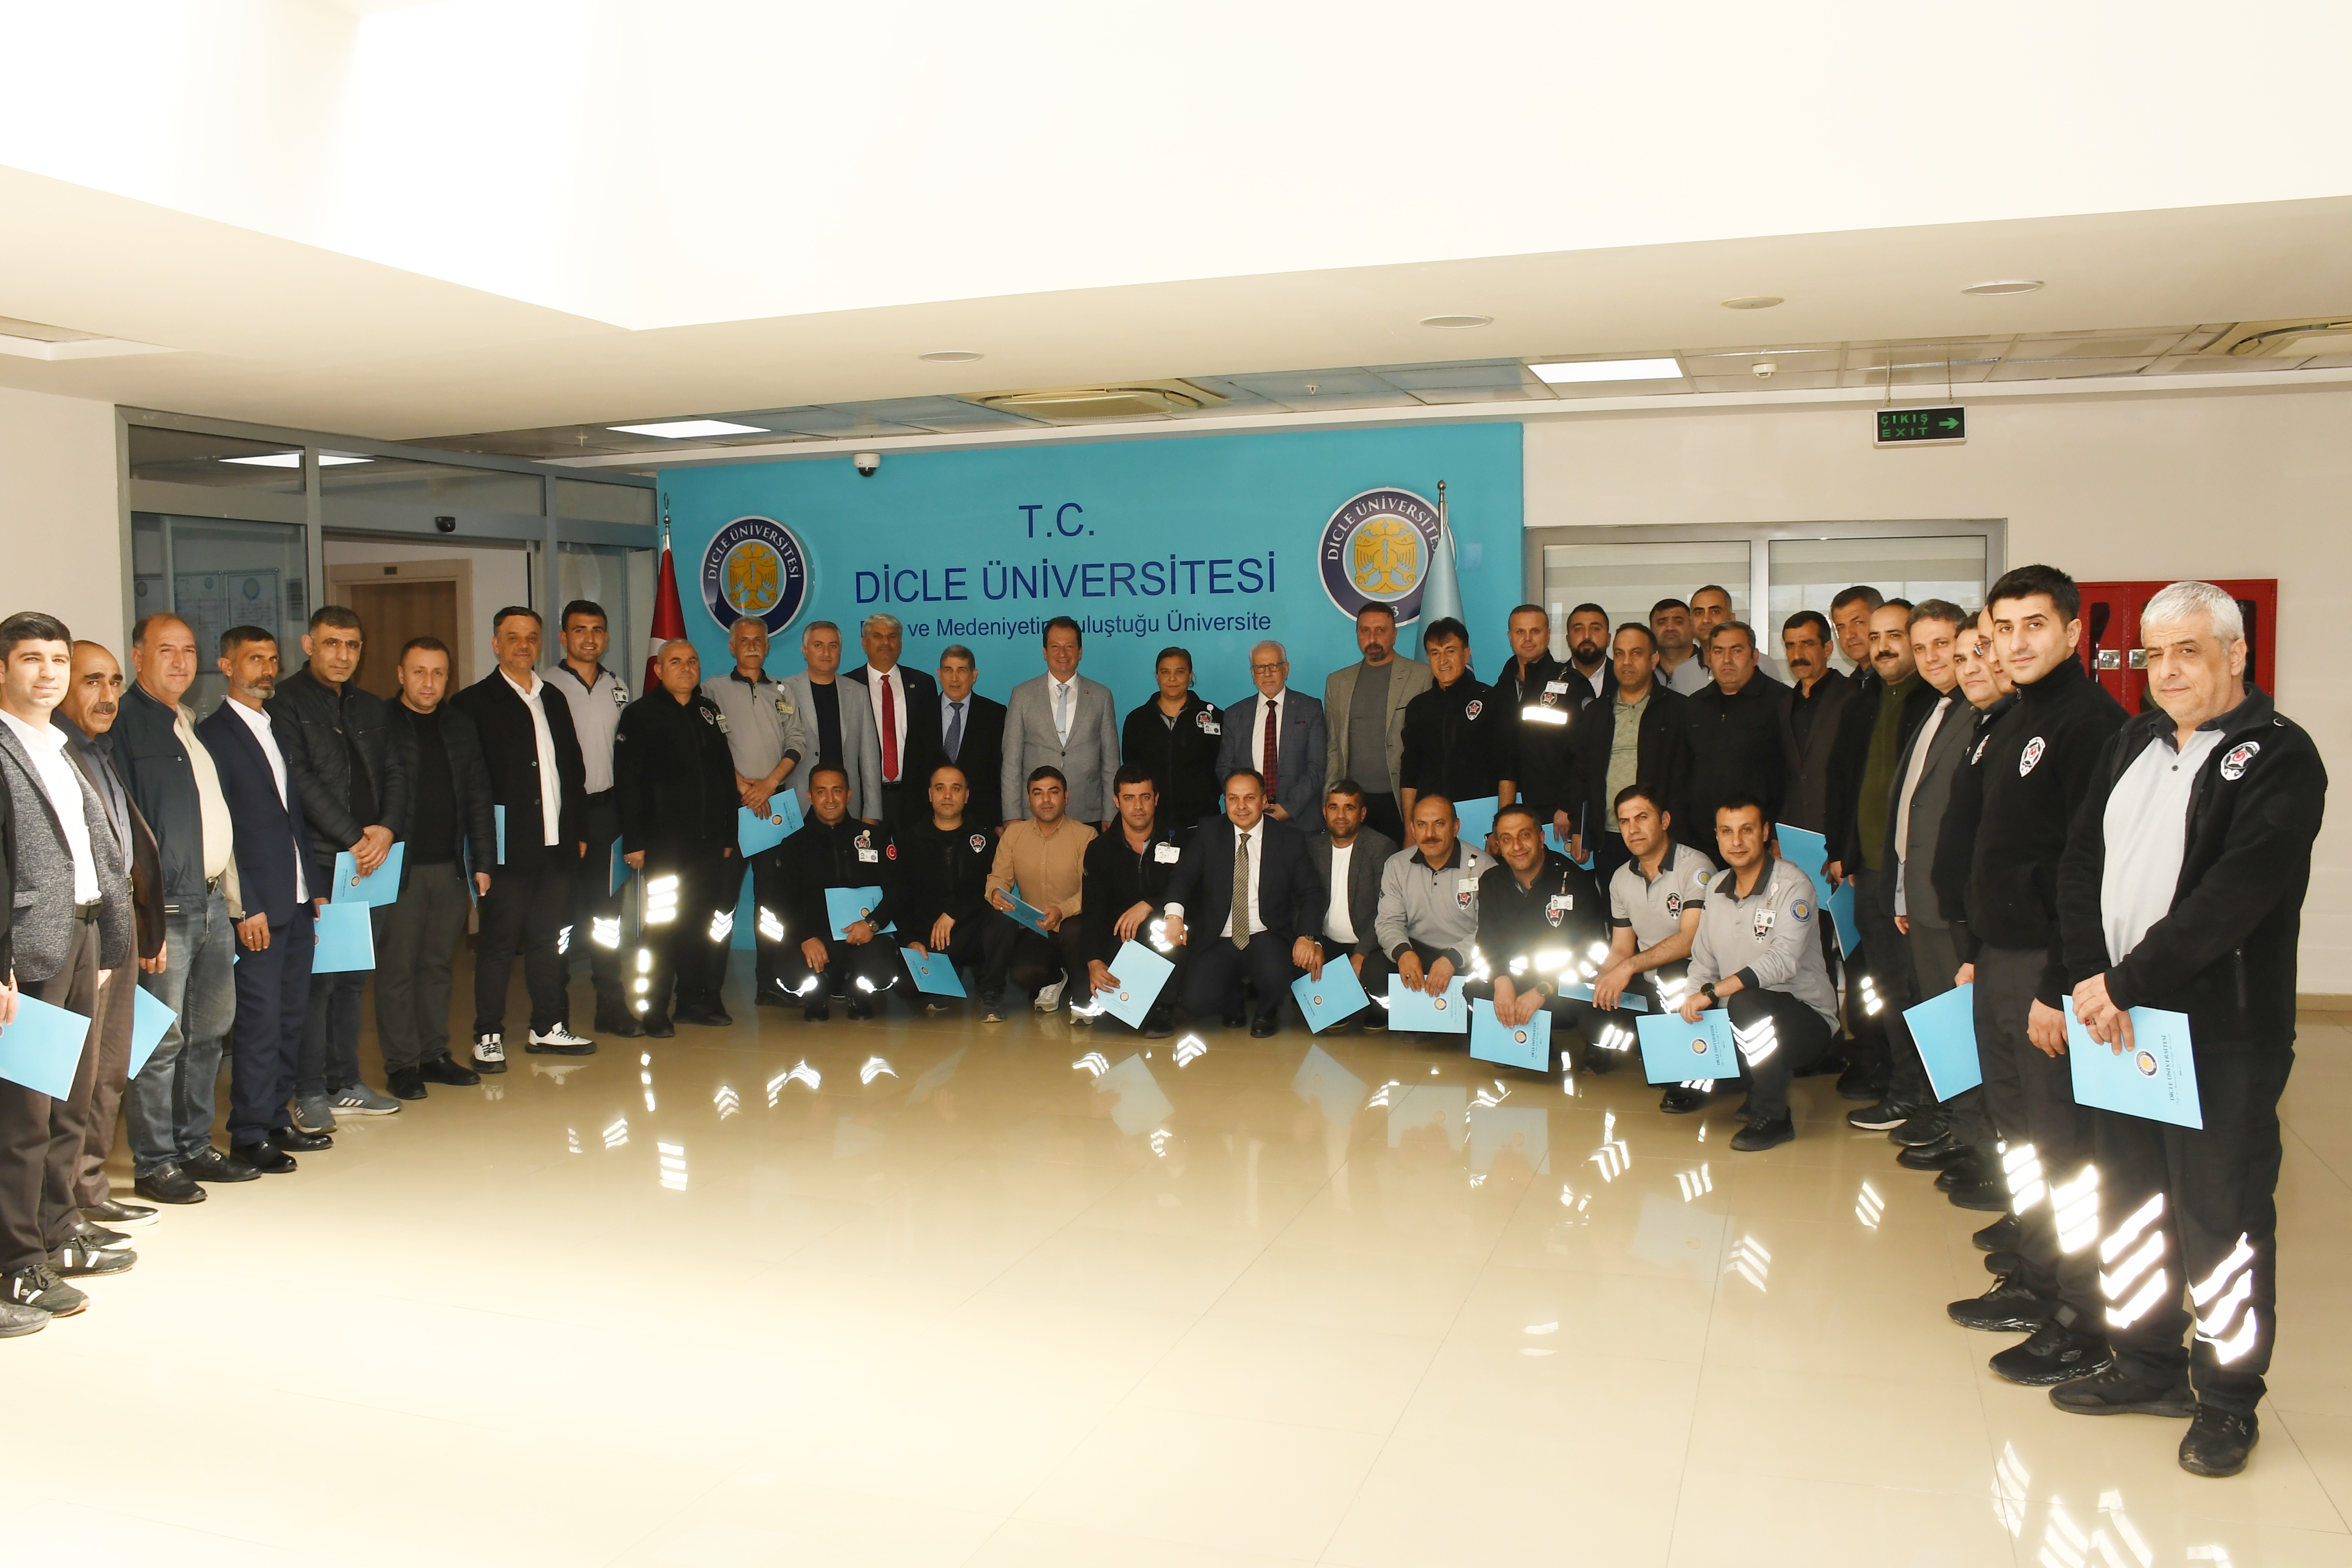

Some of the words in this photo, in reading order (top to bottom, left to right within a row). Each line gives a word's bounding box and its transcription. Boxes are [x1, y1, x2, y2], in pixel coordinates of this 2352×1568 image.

[1881, 414, 1928, 427] ÇIKIŞ
[1882, 427, 1928, 437] EXIT
[1018, 503, 1094, 538] T.C.
[1327, 513, 1355, 561] DİCLE
[1355, 495, 1439, 551] ÜNİVERSİTE
[708, 538, 730, 580] DİCLE
[730, 523, 801, 578] ÜNİVERSİTESİ
[856, 564, 968, 603] DİCLE
[983, 551, 1274, 600] ÜNİVERSİTESİ
[907, 623, 929, 637] ve
[1061, 614, 1159, 637] uluştuğu
[1168, 610, 1271, 632] Üniversite
[2161, 1035, 2172, 1080] ÜNİVERSİTESİ
